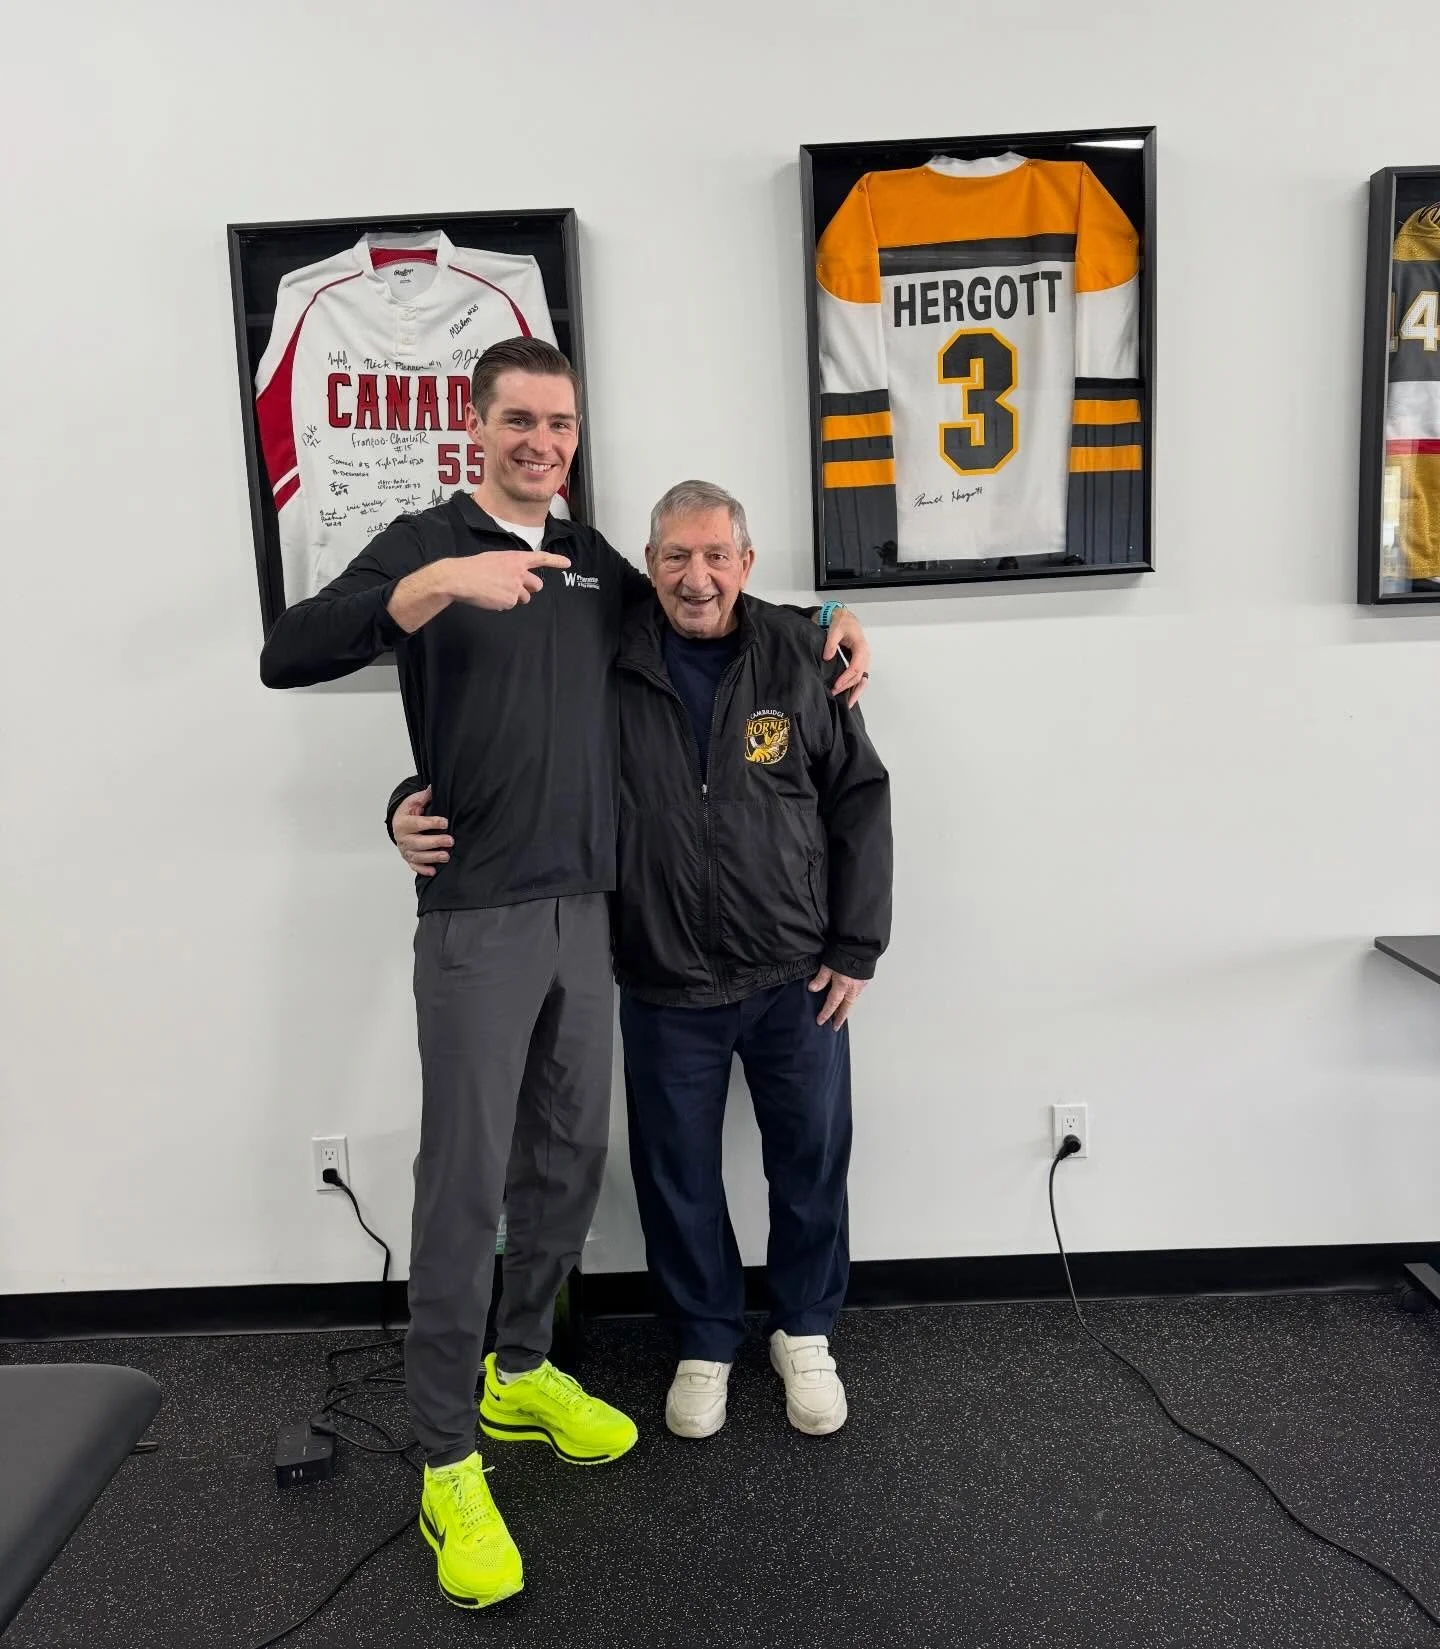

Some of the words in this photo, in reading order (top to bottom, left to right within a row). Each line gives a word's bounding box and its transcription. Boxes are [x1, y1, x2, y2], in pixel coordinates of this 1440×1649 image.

[893, 271, 1063, 328] HERGOTT
[327, 372, 472, 431] CANAD
[937, 327, 1020, 477] 3
[438, 443, 484, 485] 55
[561, 570, 577, 588] W
[750, 709, 785, 719] CAMBRIDGE
